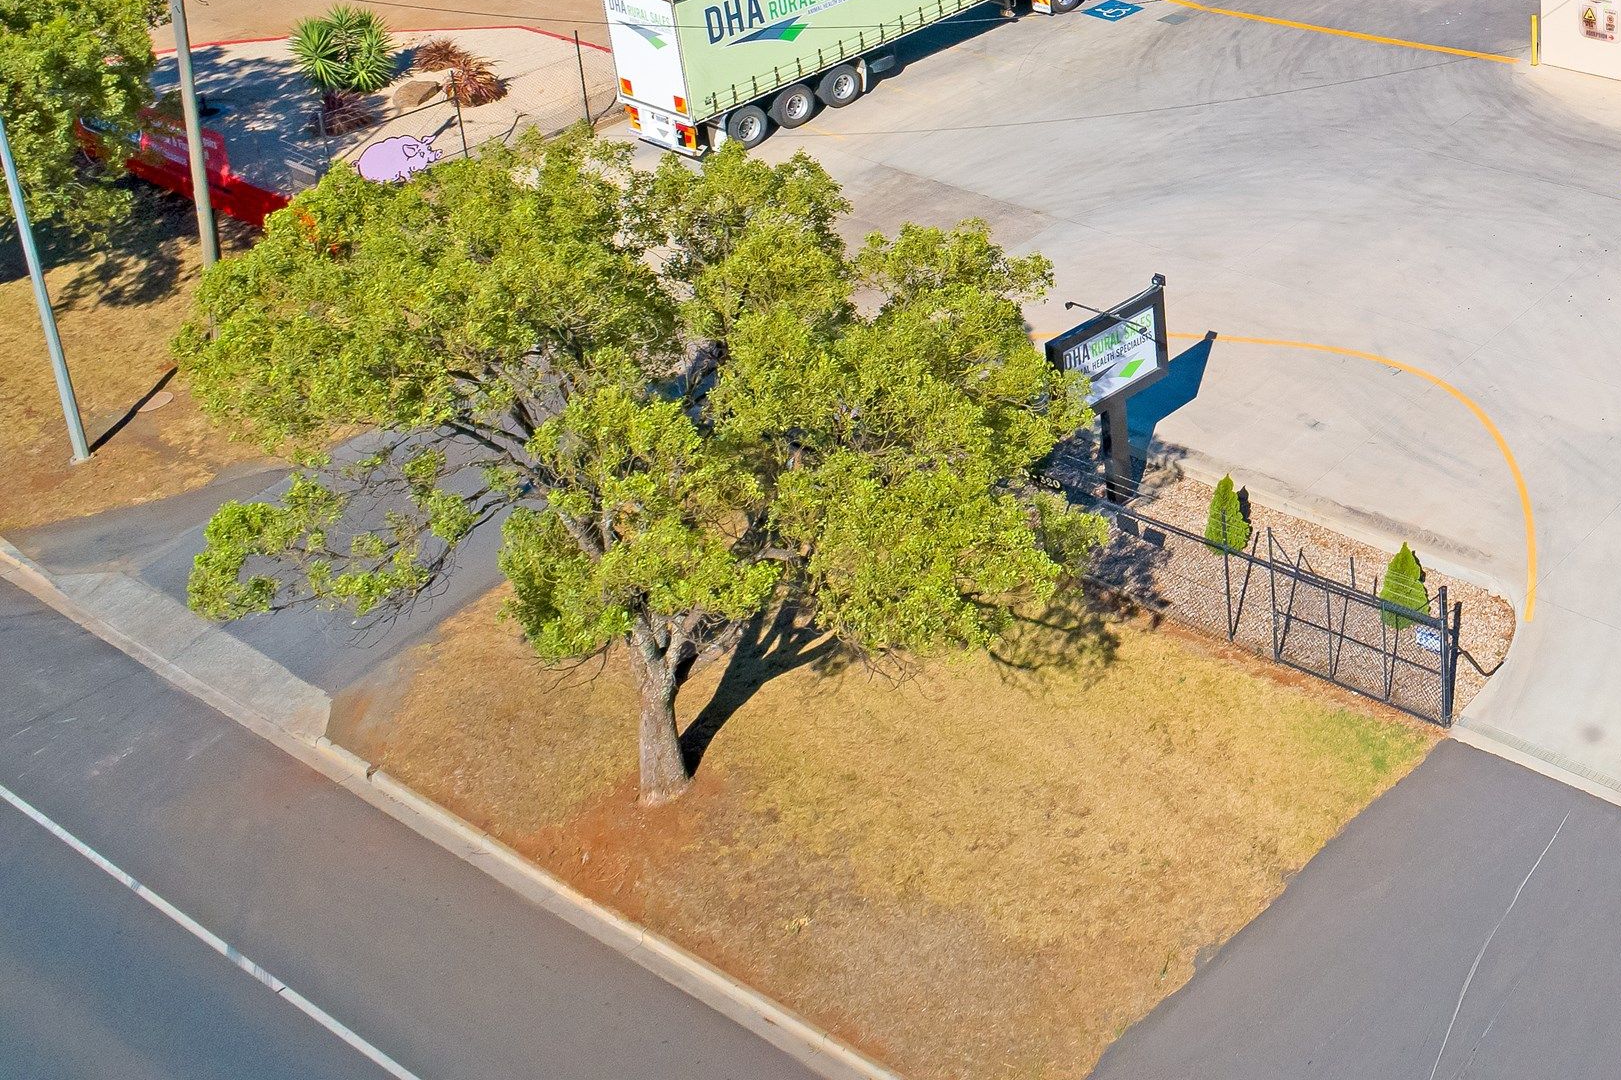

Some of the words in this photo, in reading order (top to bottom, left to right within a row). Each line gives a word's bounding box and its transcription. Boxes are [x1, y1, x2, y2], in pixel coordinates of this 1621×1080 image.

[626, 5, 649, 22] RURAL
[649, 11, 671, 25] SALES
[1064, 343, 1091, 371] DHA
[1091, 331, 1122, 358] RURAL
[1092, 351, 1115, 371] HEALTH
[1115, 331, 1153, 358] SPECIALISTS
[1039, 475, 1061, 489] 320
